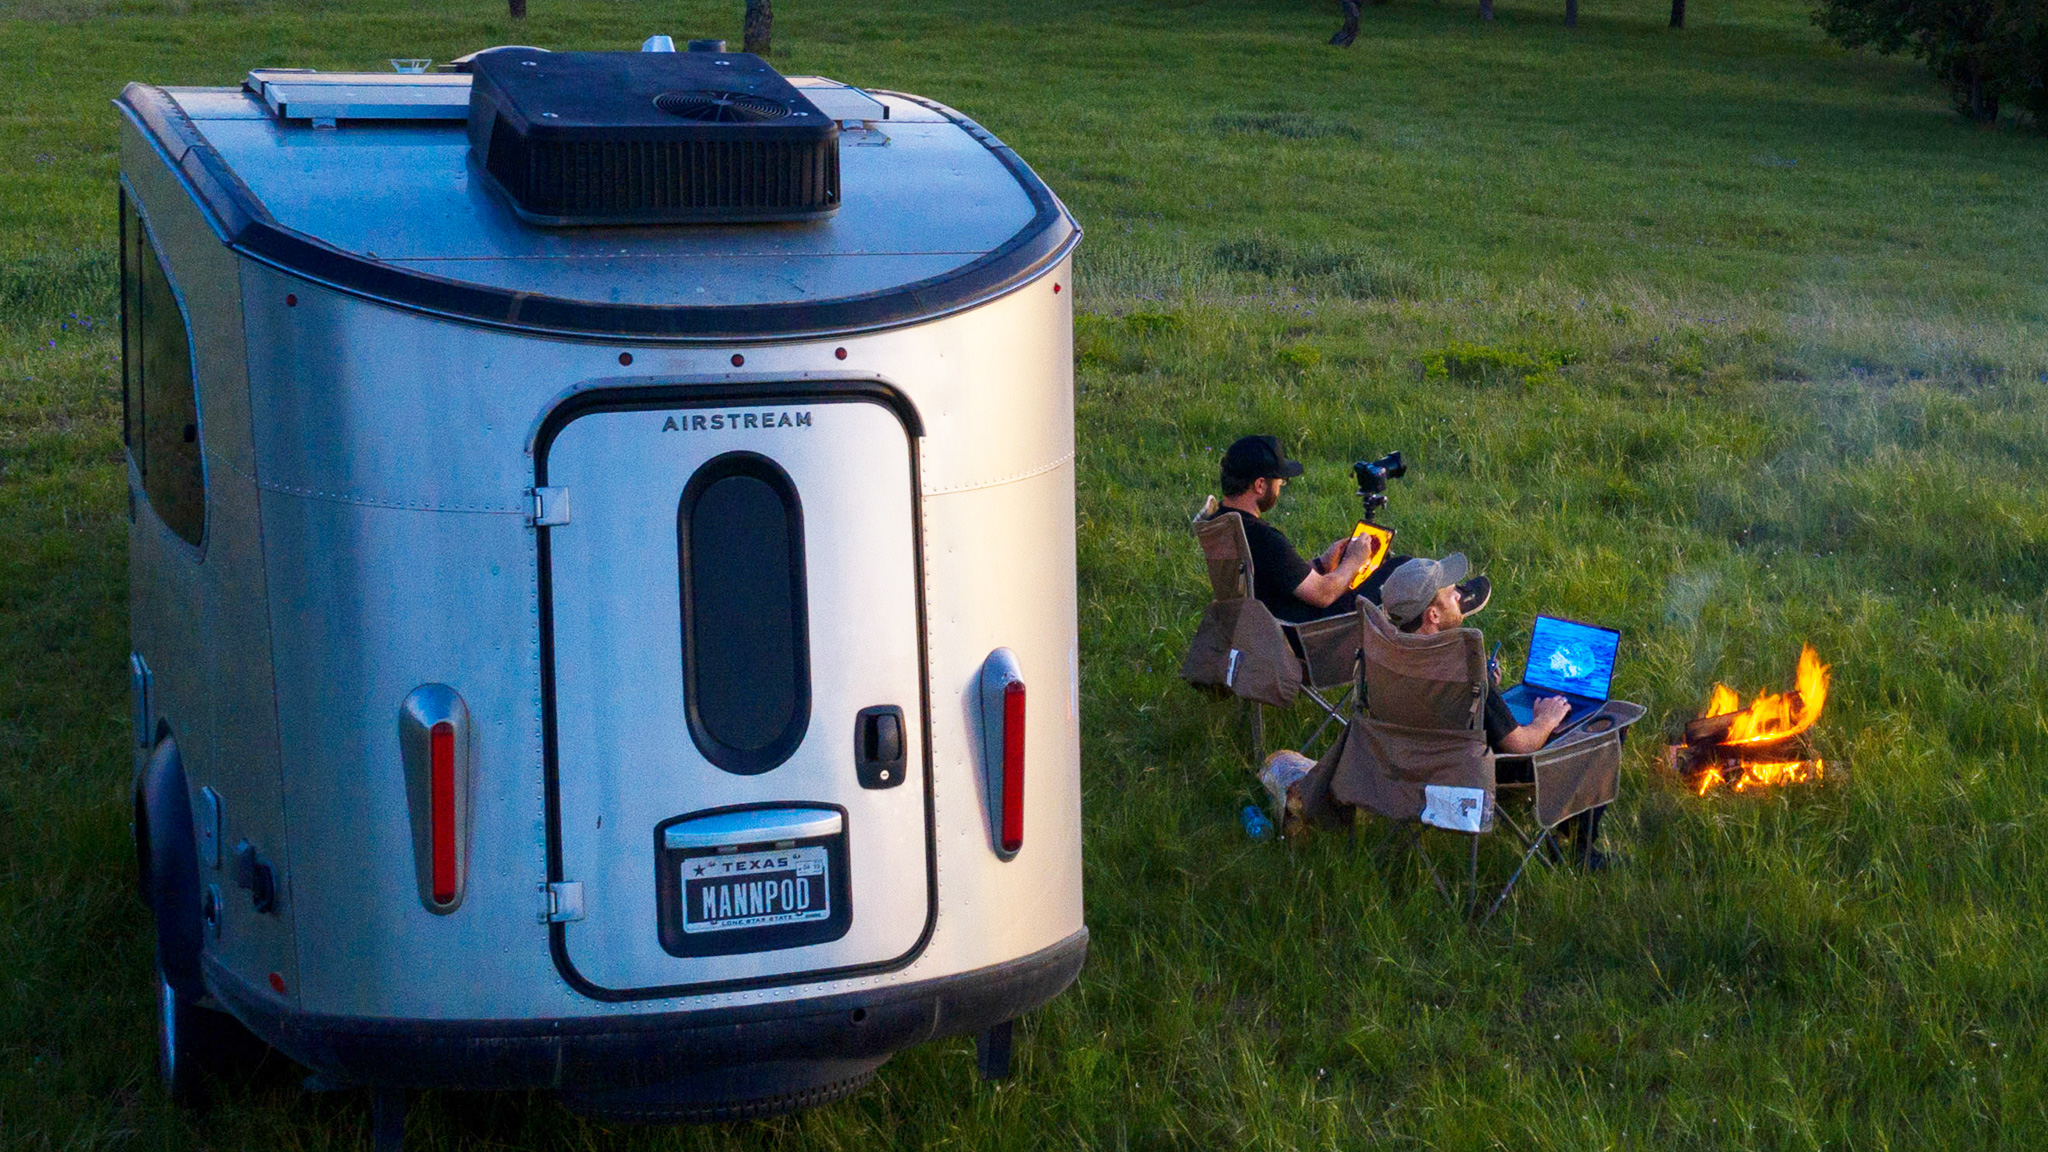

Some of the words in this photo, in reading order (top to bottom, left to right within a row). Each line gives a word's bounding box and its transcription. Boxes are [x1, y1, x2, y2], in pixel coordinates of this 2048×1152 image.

[662, 411, 812, 432] AIRSTREAM
[722, 857, 788, 872] TEXAS
[702, 878, 810, 919] MANNPOD
